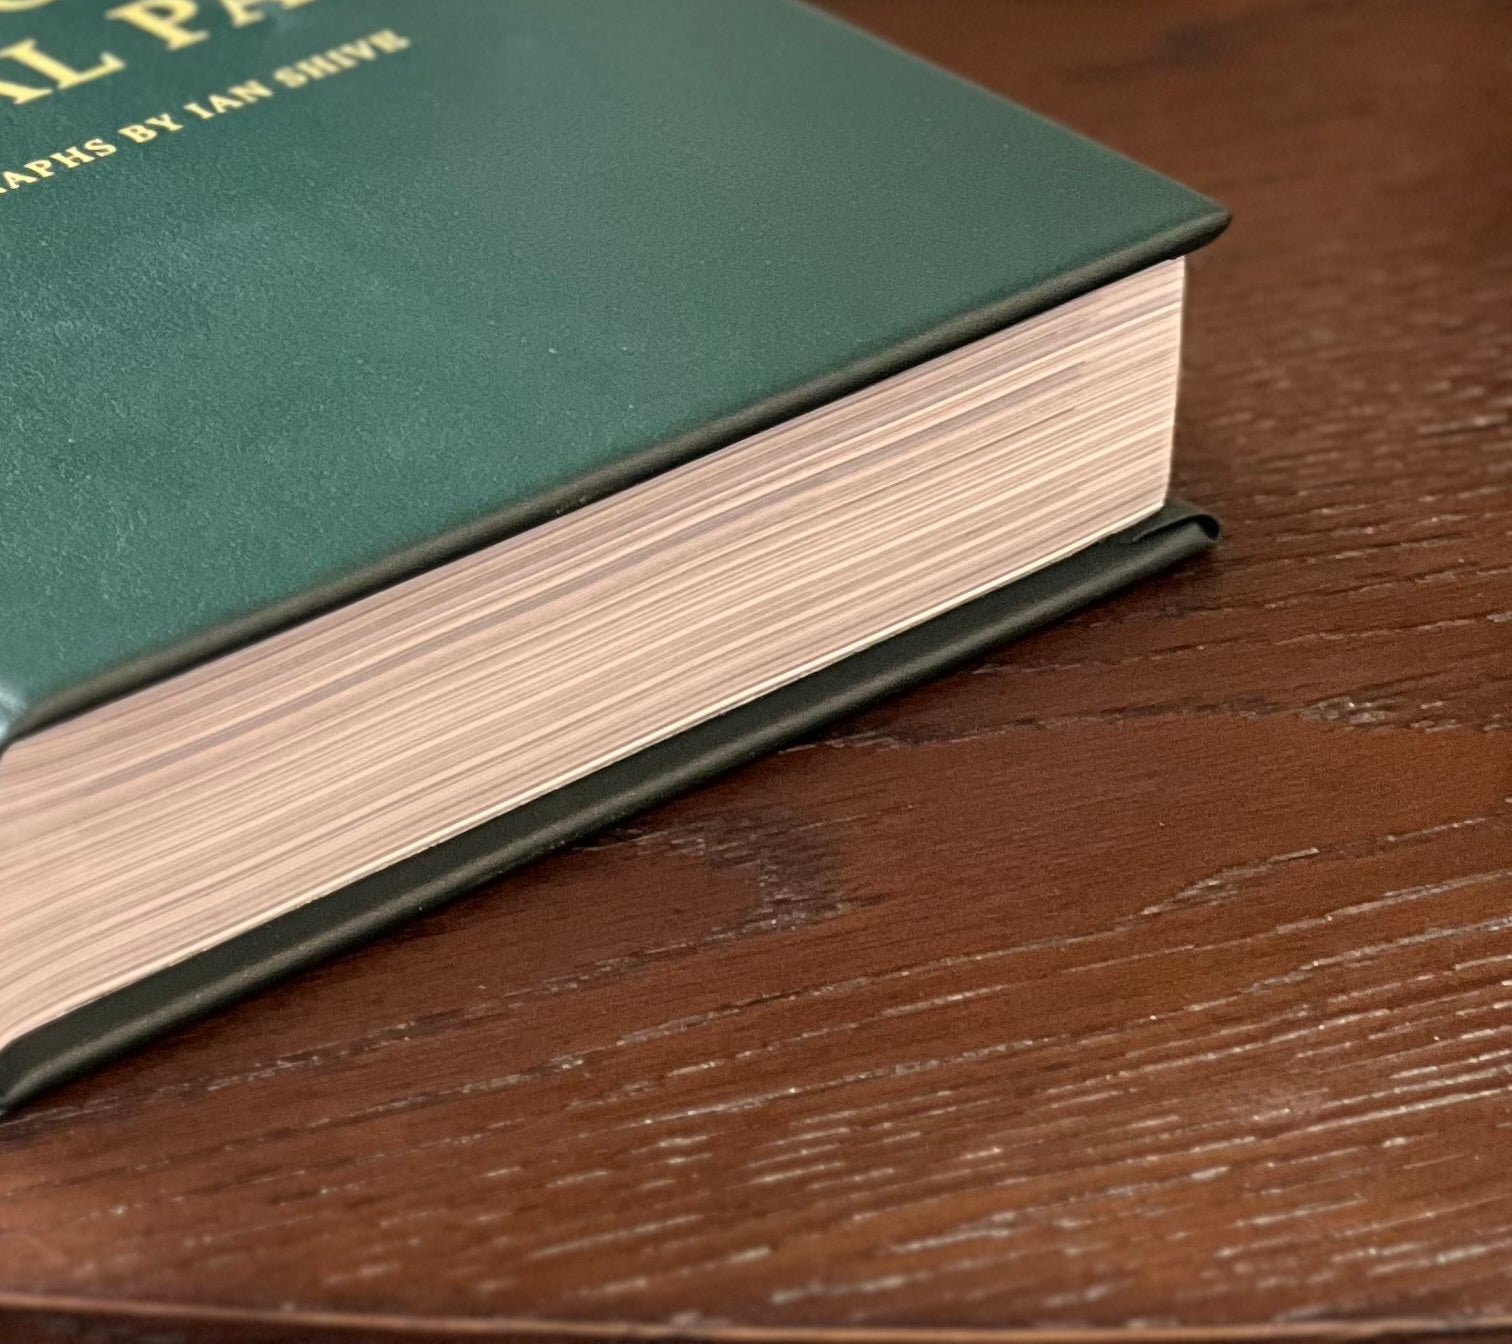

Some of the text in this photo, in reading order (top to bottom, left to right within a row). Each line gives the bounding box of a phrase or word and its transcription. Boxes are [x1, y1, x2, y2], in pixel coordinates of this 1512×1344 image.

[118, 112, 184, 145] BY
[184, 78, 274, 121] IAN
[273, 28, 412, 89] SHIVE
